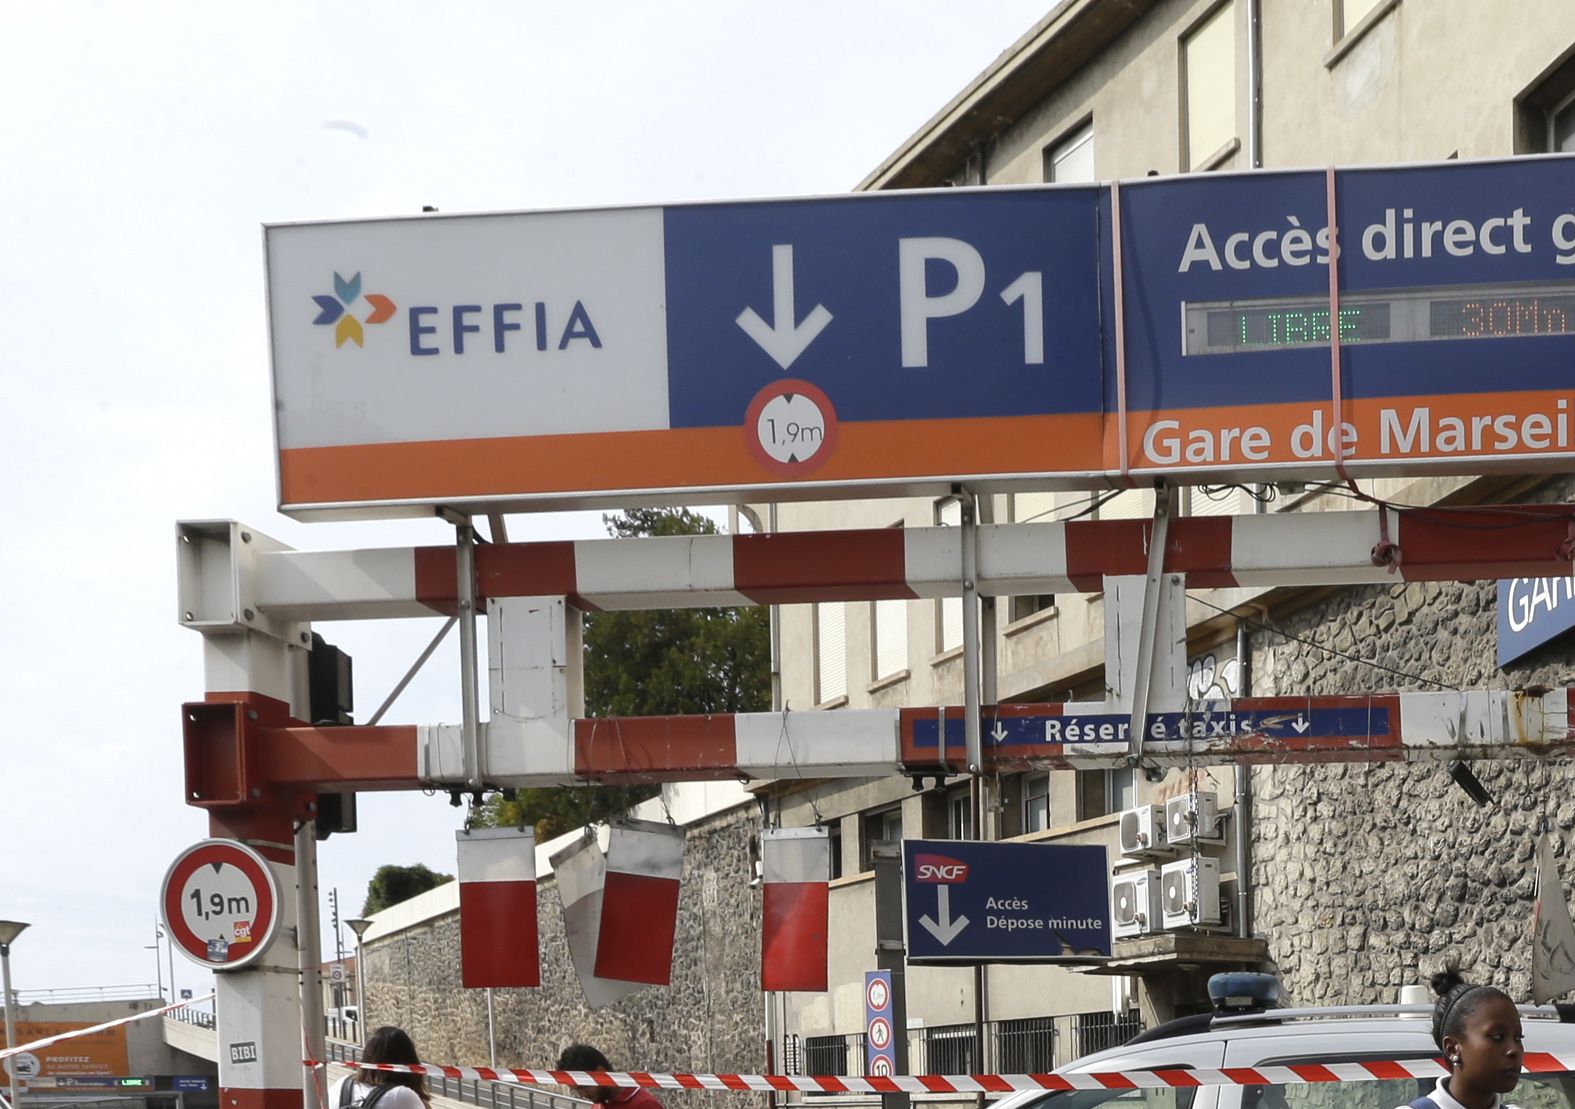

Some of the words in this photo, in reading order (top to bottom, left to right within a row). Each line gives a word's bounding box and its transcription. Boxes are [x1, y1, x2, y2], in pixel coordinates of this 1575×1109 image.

[1178, 215, 1341, 272] Accès
[1361, 207, 1533, 260] direct
[898, 236, 1044, 368] P1
[409, 300, 602, 356] EFFIA
[1241, 310, 1361, 346] LIBRE
[767, 418, 823, 446] 1,9m
[1143, 419, 1271, 465] Gare
[1290, 409, 1359, 458] de
[1045, 715, 1166, 742] Réseré
[1178, 713, 1253, 740] taxis
[917, 864, 967, 880] SNCF
[189, 887, 250, 921] 1,9m
[985, 897, 1029, 910] Accès
[234, 925, 251, 937] cgt
[986, 915, 1044, 931] Dépose
[1048, 916, 1102, 930] minute
[231, 1045, 256, 1060] BIBI
[875, 1064, 888, 1077] 10
